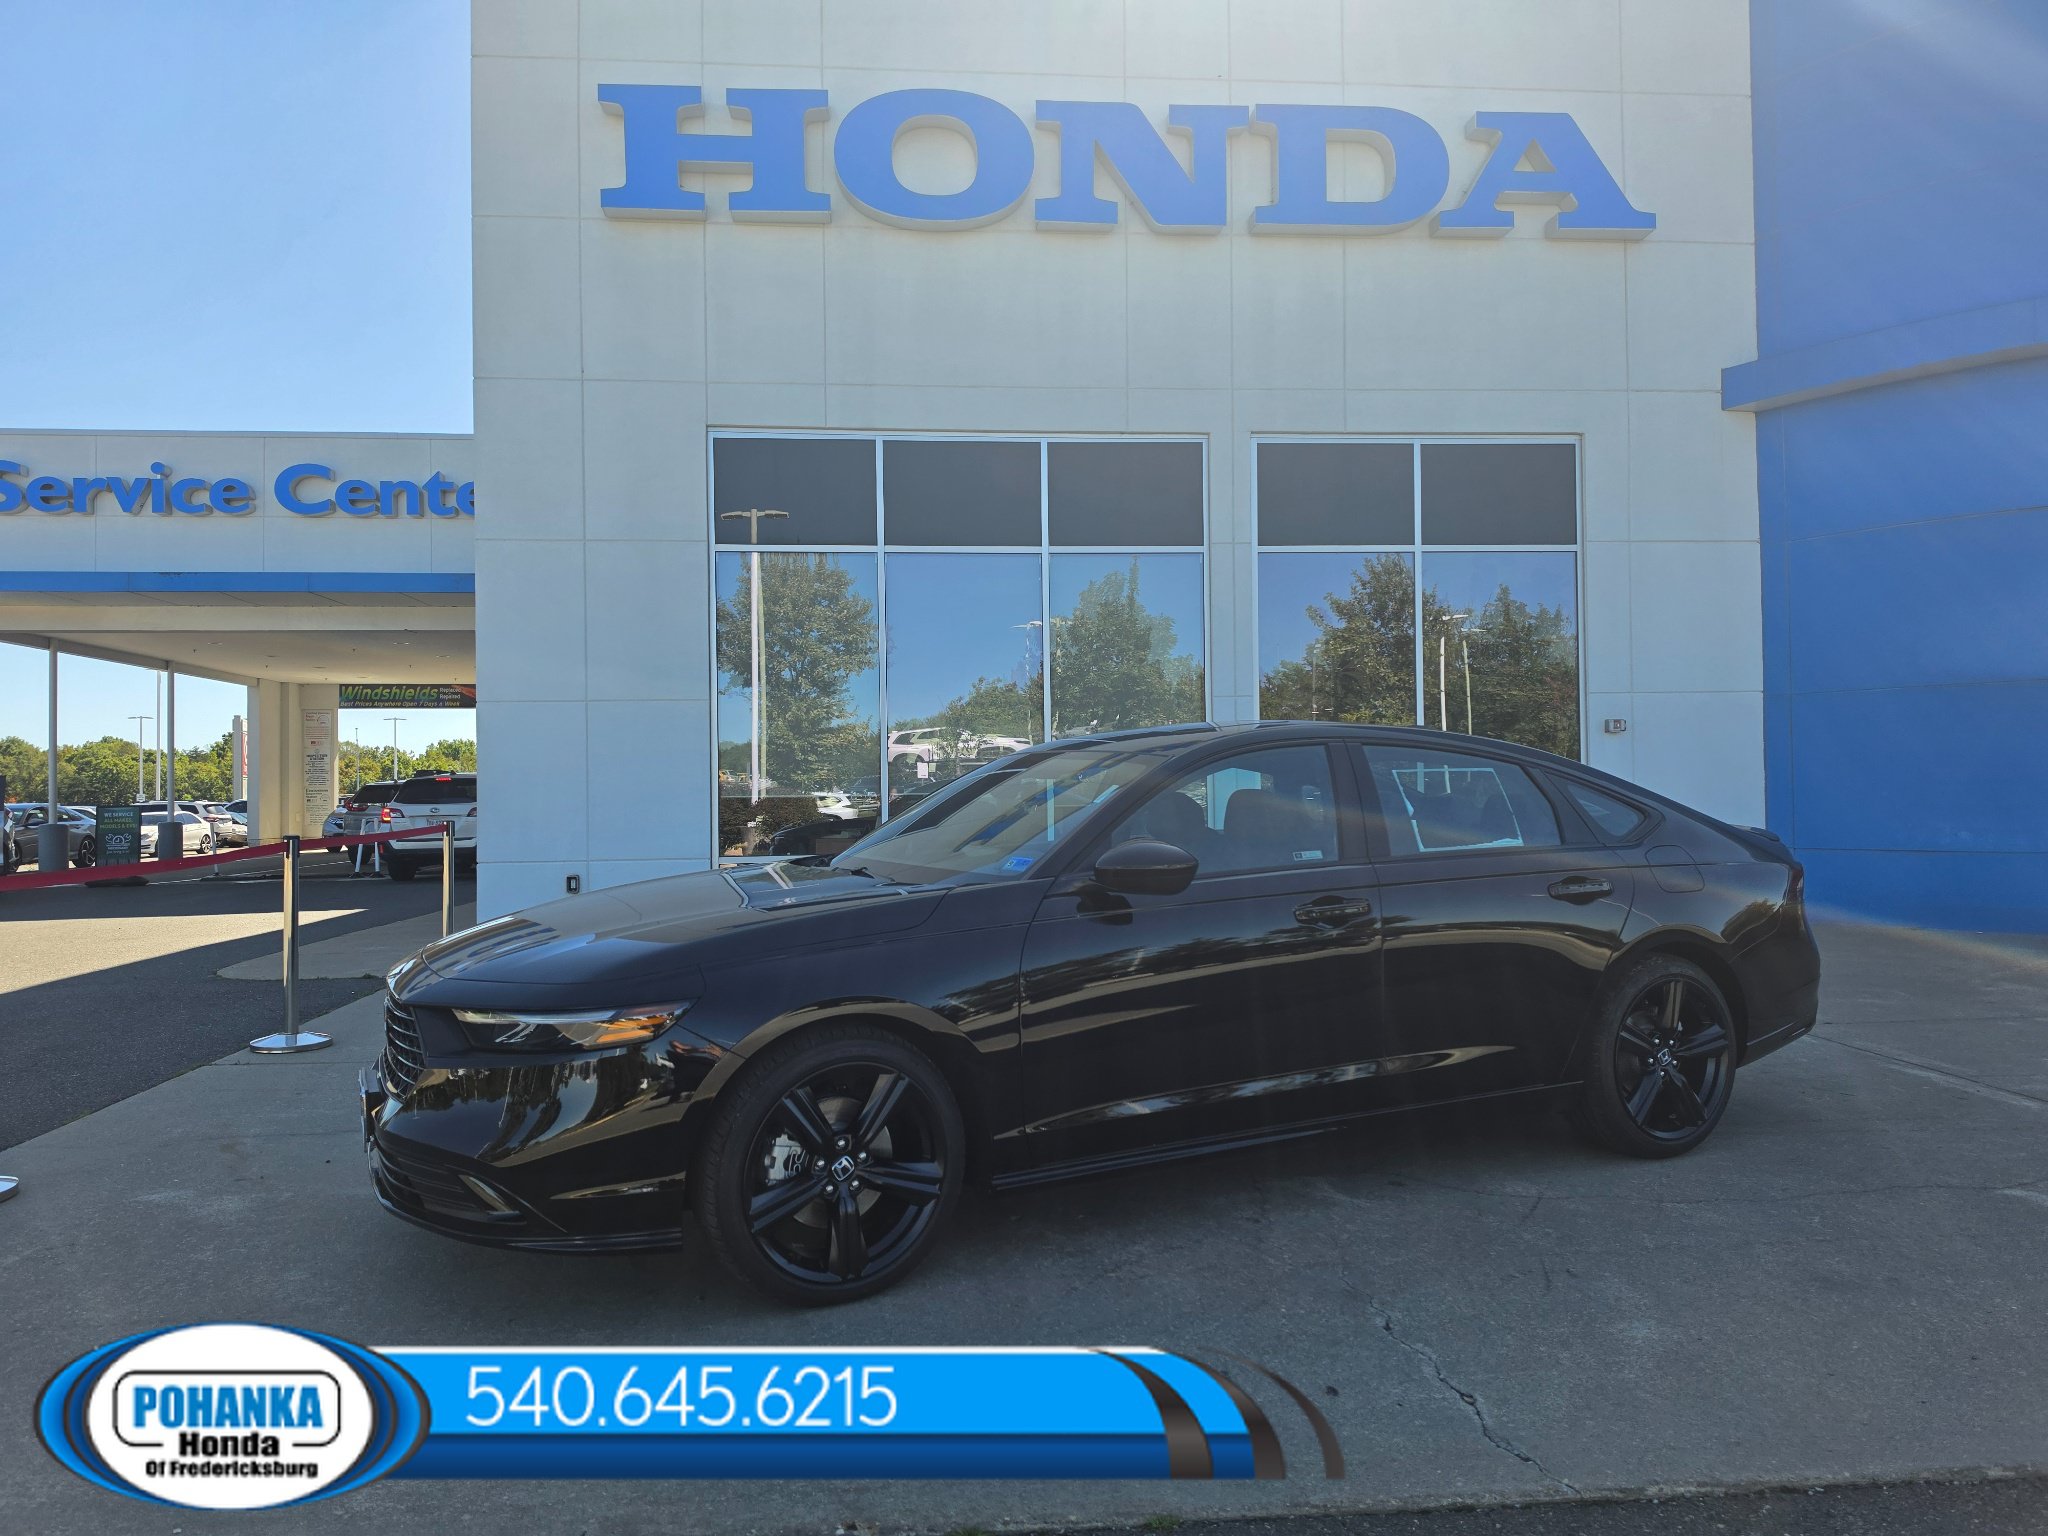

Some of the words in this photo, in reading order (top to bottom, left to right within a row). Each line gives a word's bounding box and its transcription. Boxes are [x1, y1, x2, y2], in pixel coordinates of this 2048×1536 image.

[598, 84, 1656, 239] HONDA
[0, 459, 254, 515] Service
[341, 685, 438, 700] Windshields
